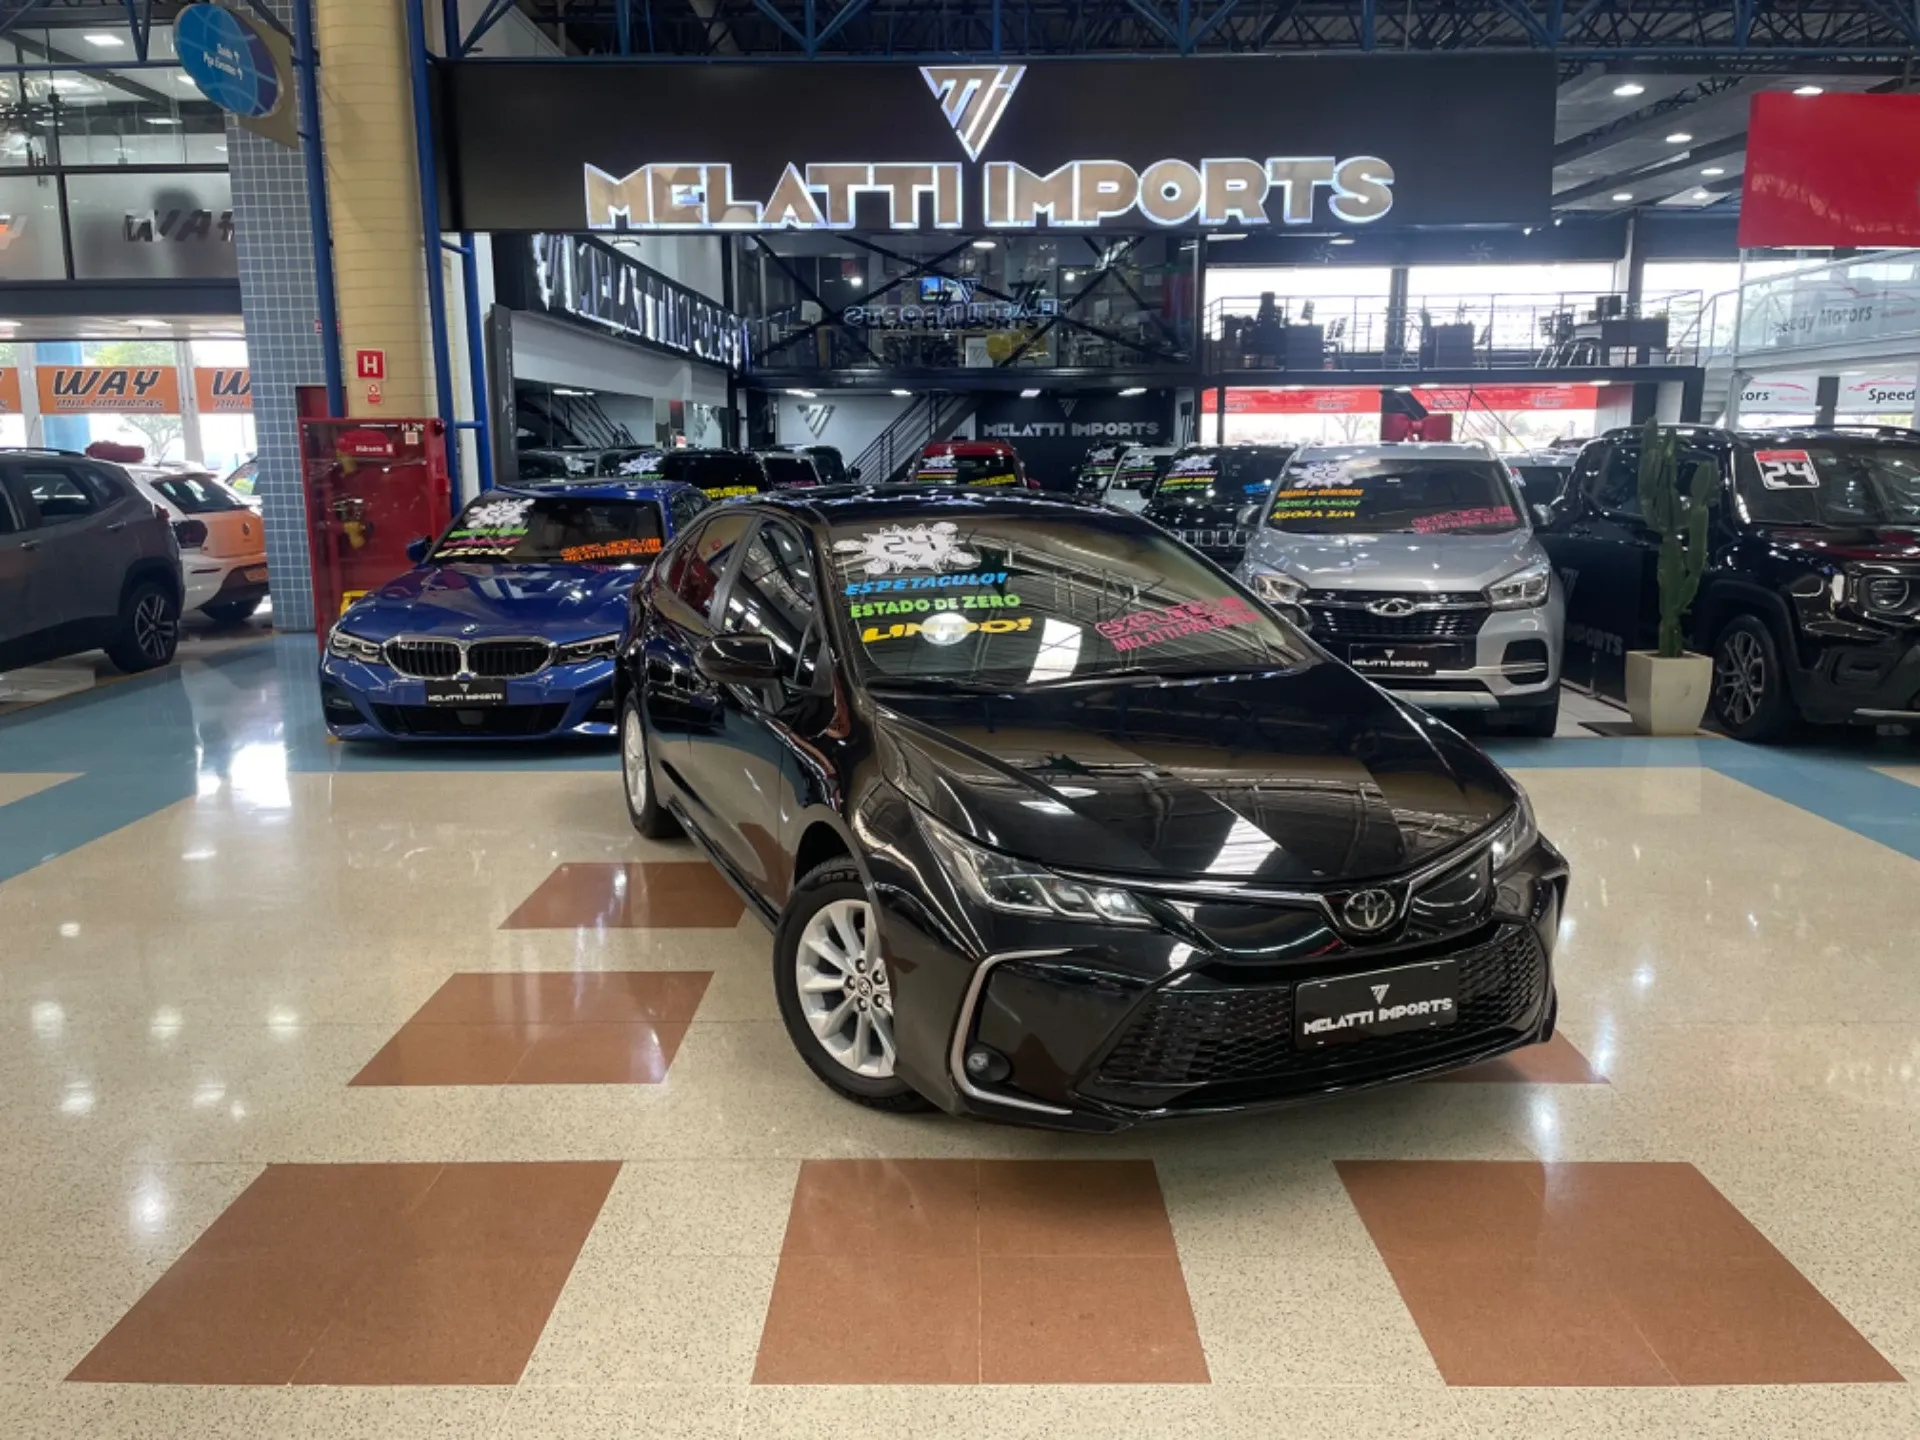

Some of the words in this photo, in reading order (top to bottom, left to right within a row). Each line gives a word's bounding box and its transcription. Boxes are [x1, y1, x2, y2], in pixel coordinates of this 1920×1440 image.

[584, 161, 962, 229] MELATTI
[984, 156, 1395, 227] IMPORTS
[363, 356, 378, 374] H
[52, 370, 162, 396] WAY
[1868, 388, 1915, 404] Speed
[984, 423, 1065, 437] MELATTI
[1072, 422, 1160, 437] IMPORTS
[1764, 462, 1815, 488] 24
[851, 599, 930, 618] ESTADO
[935, 598, 958, 610] DE
[961, 594, 1021, 609] ZERO
[1111, 626, 1181, 651] MELATTI
[1304, 1010, 1374, 1034] MELATTI
[1379, 998, 1453, 1021] IMPORTS
